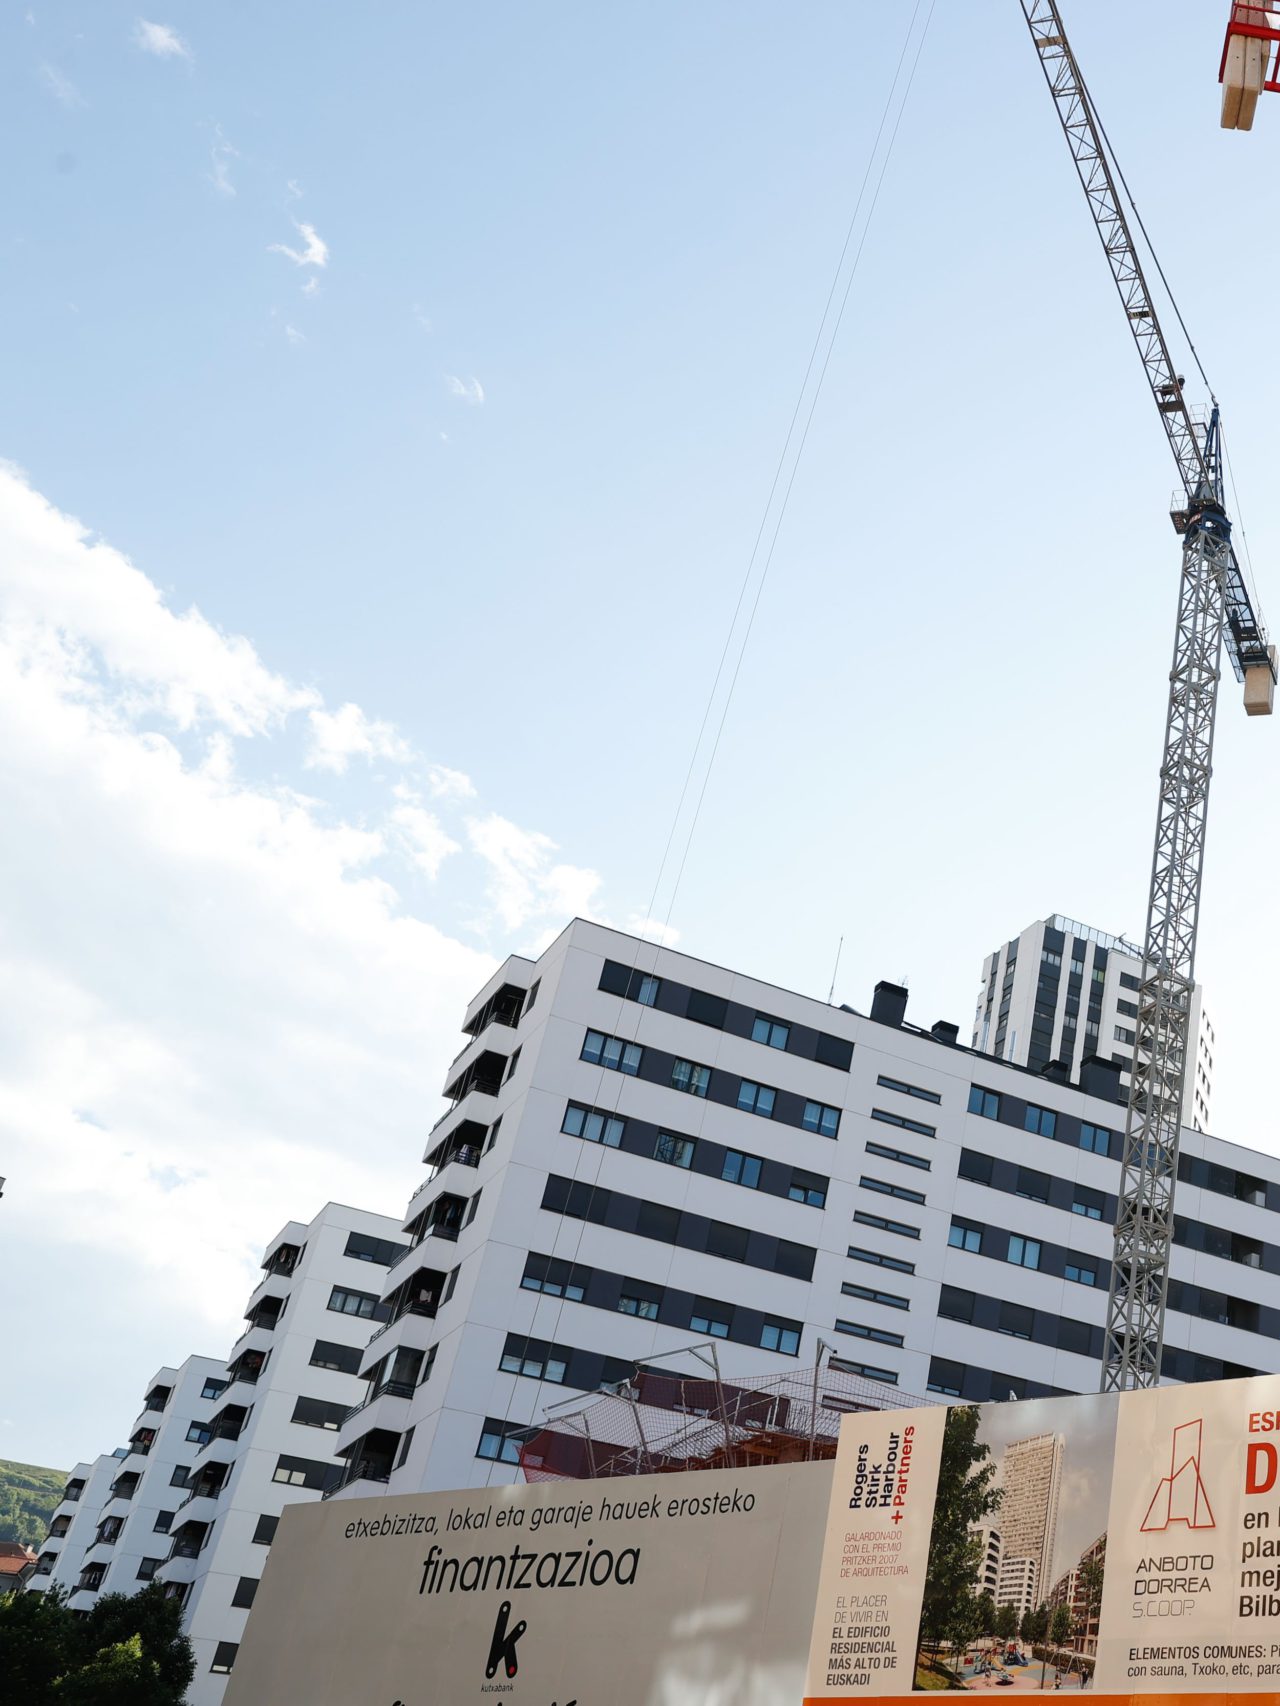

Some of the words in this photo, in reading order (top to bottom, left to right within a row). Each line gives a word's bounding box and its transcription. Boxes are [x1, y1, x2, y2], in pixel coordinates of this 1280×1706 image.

[879, 1432, 899, 1507] Harbour
[893, 1426, 915, 1506] Partners
[849, 1444, 868, 1508] Rogers
[865, 1464, 882, 1508] Stirk
[344, 1512, 439, 1539] etxebizitza,
[446, 1505, 491, 1531] lokal
[495, 1506, 525, 1527] eta
[529, 1500, 592, 1531] garaje
[600, 1494, 660, 1521] hauek
[667, 1488, 756, 1518] erosteko
[1244, 1510, 1269, 1529] en
[845, 1531, 901, 1542] GALARDONADO
[844, 1544, 859, 1554] CON
[862, 1544, 870, 1553] EL
[873, 1543, 901, 1552] PREMIO
[419, 1539, 640, 1595] finantzazioa
[842, 1556, 876, 1565] PRITZKER
[879, 1555, 898, 1564] 2007
[1136, 1554, 1213, 1574] ANBOTO
[841, 1568, 851, 1577] DE
[853, 1566, 908, 1577] ARQUITECTURA
[1134, 1577, 1211, 1596] DORREA
[836, 1597, 847, 1608] EL
[850, 1595, 887, 1607] PLACER
[1132, 1599, 1195, 1618] S.COOP.
[834, 1611, 847, 1623] DE
[850, 1611, 873, 1623] VIVIR
[875, 1610, 888, 1622] EN
[832, 1627, 844, 1638] EL
[847, 1626, 890, 1638] EDIFICIO
[831, 1641, 896, 1654] RESIDENCIAL
[1129, 1647, 1199, 1661] ELEMENTOS
[1203, 1645, 1267, 1659] COMUNES:
[828, 1656, 851, 1670] MÁS
[854, 1657, 881, 1669] ALTO
[883, 1657, 897, 1668] DE
[1127, 1666, 1147, 1677] con
[1150, 1665, 1188, 1677] sauna,
[1191, 1662, 1229, 1677] Txoko,
[826, 1674, 870, 1685] EUSKADI
[480, 1683, 514, 1693] kutxabank
